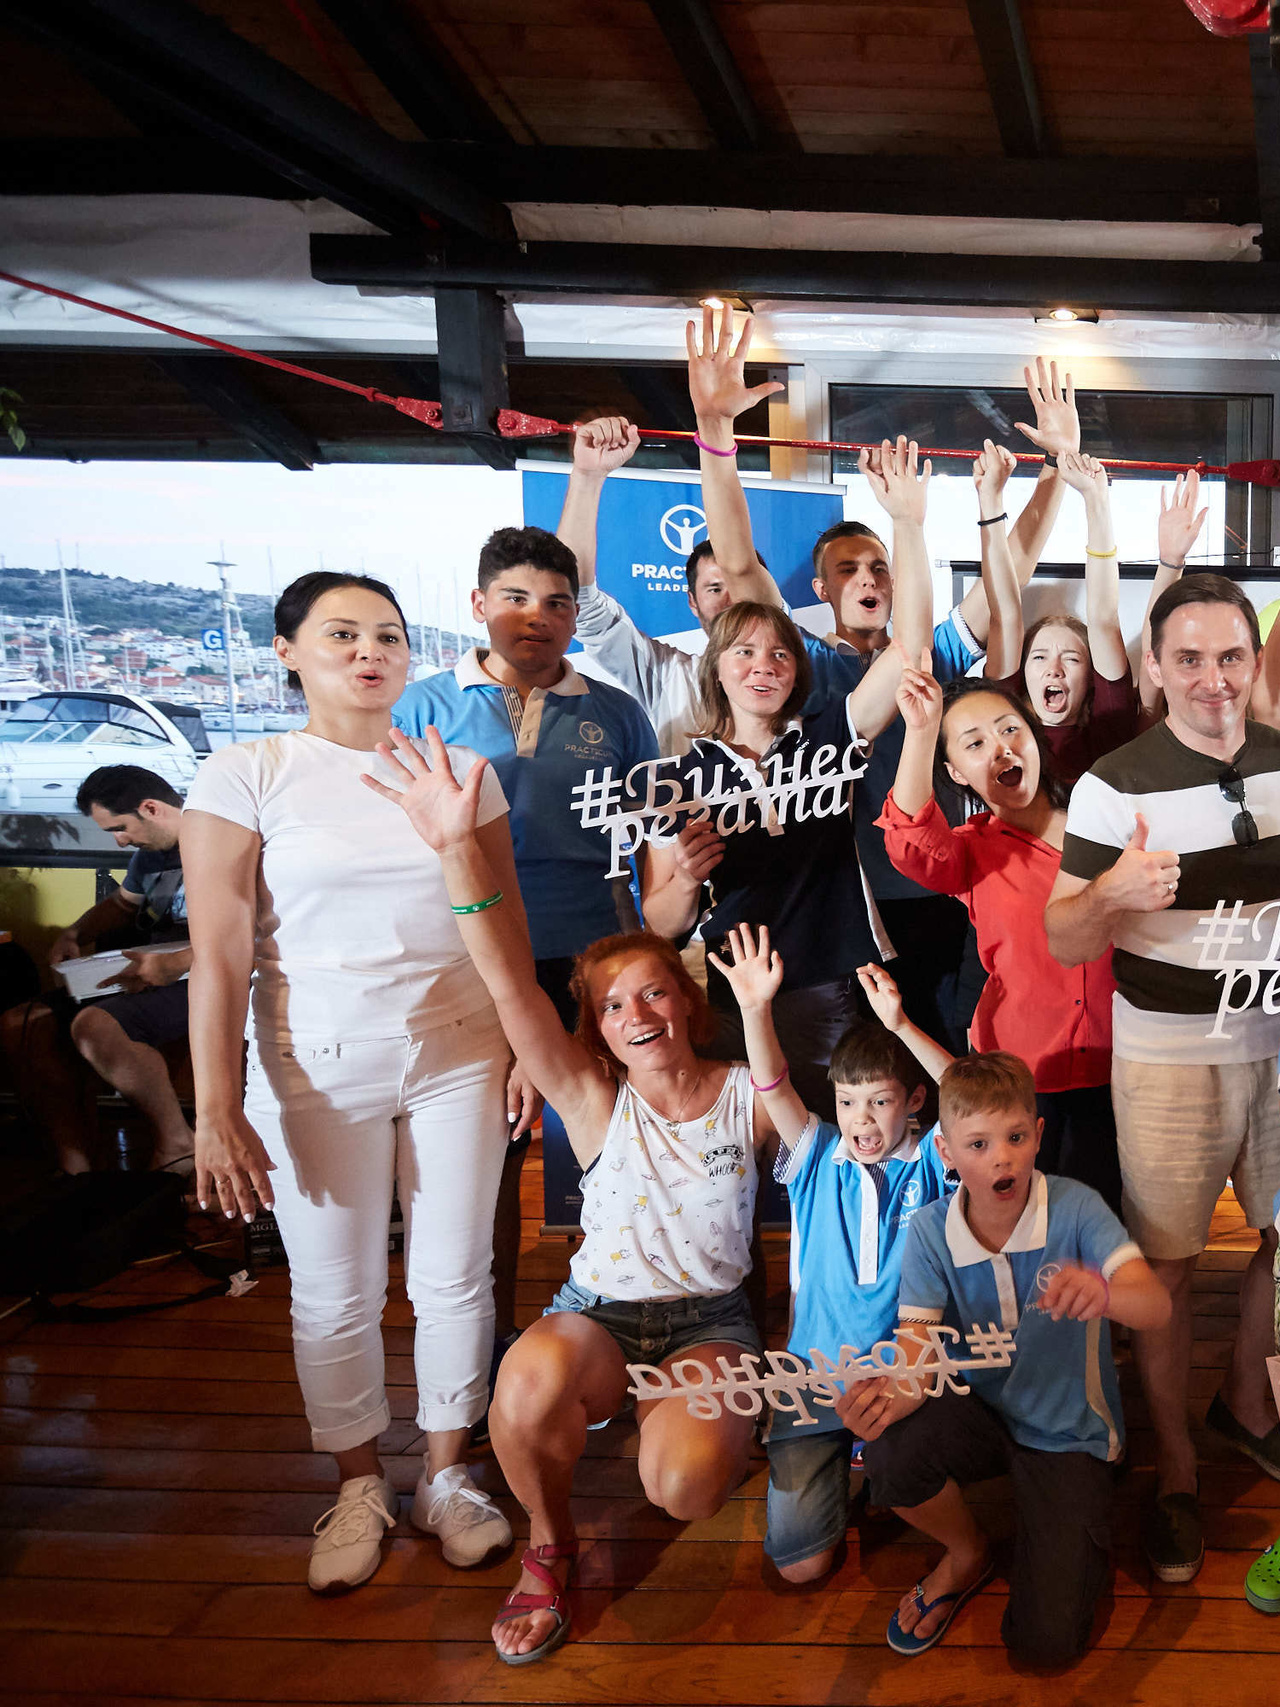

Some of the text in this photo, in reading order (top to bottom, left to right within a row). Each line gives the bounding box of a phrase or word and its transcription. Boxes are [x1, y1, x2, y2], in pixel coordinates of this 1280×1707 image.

[631, 563, 687, 580] PRAC
[204, 629, 223, 649] G
[564, 744, 613, 758] PRACTICU
[570, 738, 869, 828] #Бизнес
[600, 778, 852, 879] регата
